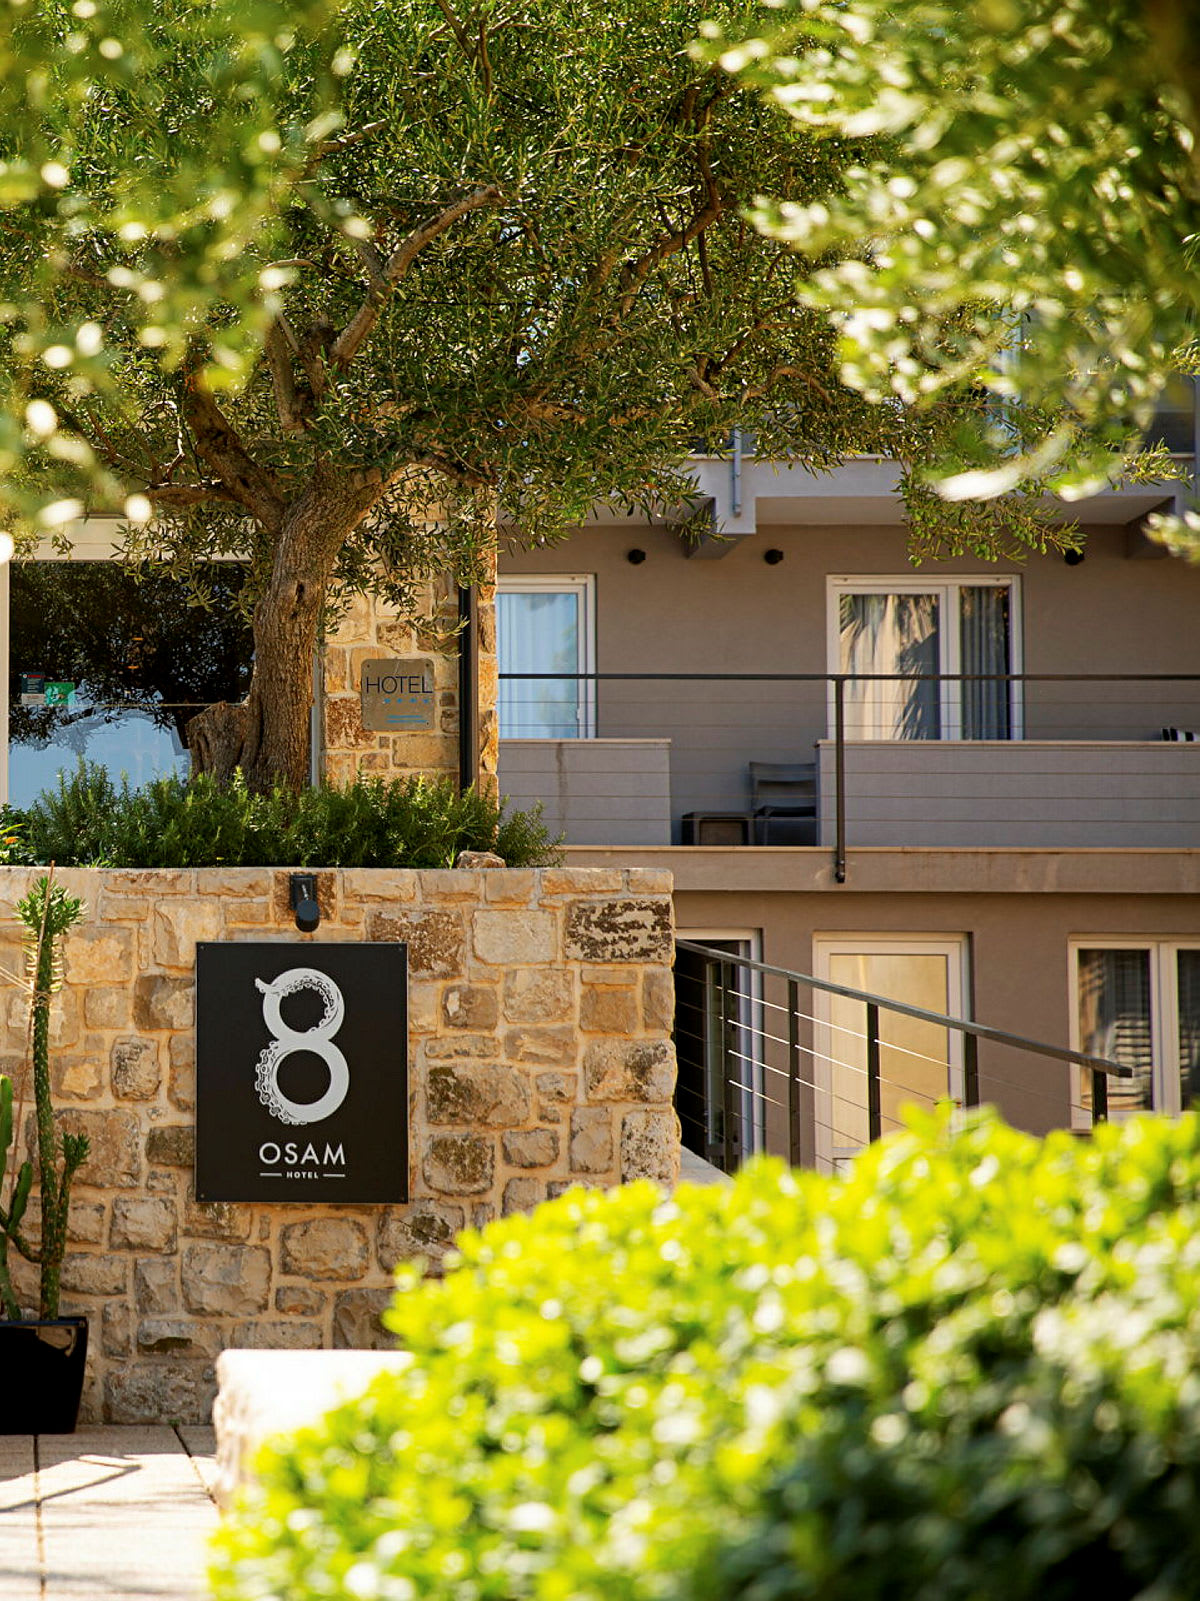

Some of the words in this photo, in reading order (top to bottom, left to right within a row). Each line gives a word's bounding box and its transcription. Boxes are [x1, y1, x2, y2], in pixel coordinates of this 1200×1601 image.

[366, 675, 434, 694] HOTEL
[258, 1142, 346, 1165] OSAM
[286, 1171, 319, 1179] HOTEL
